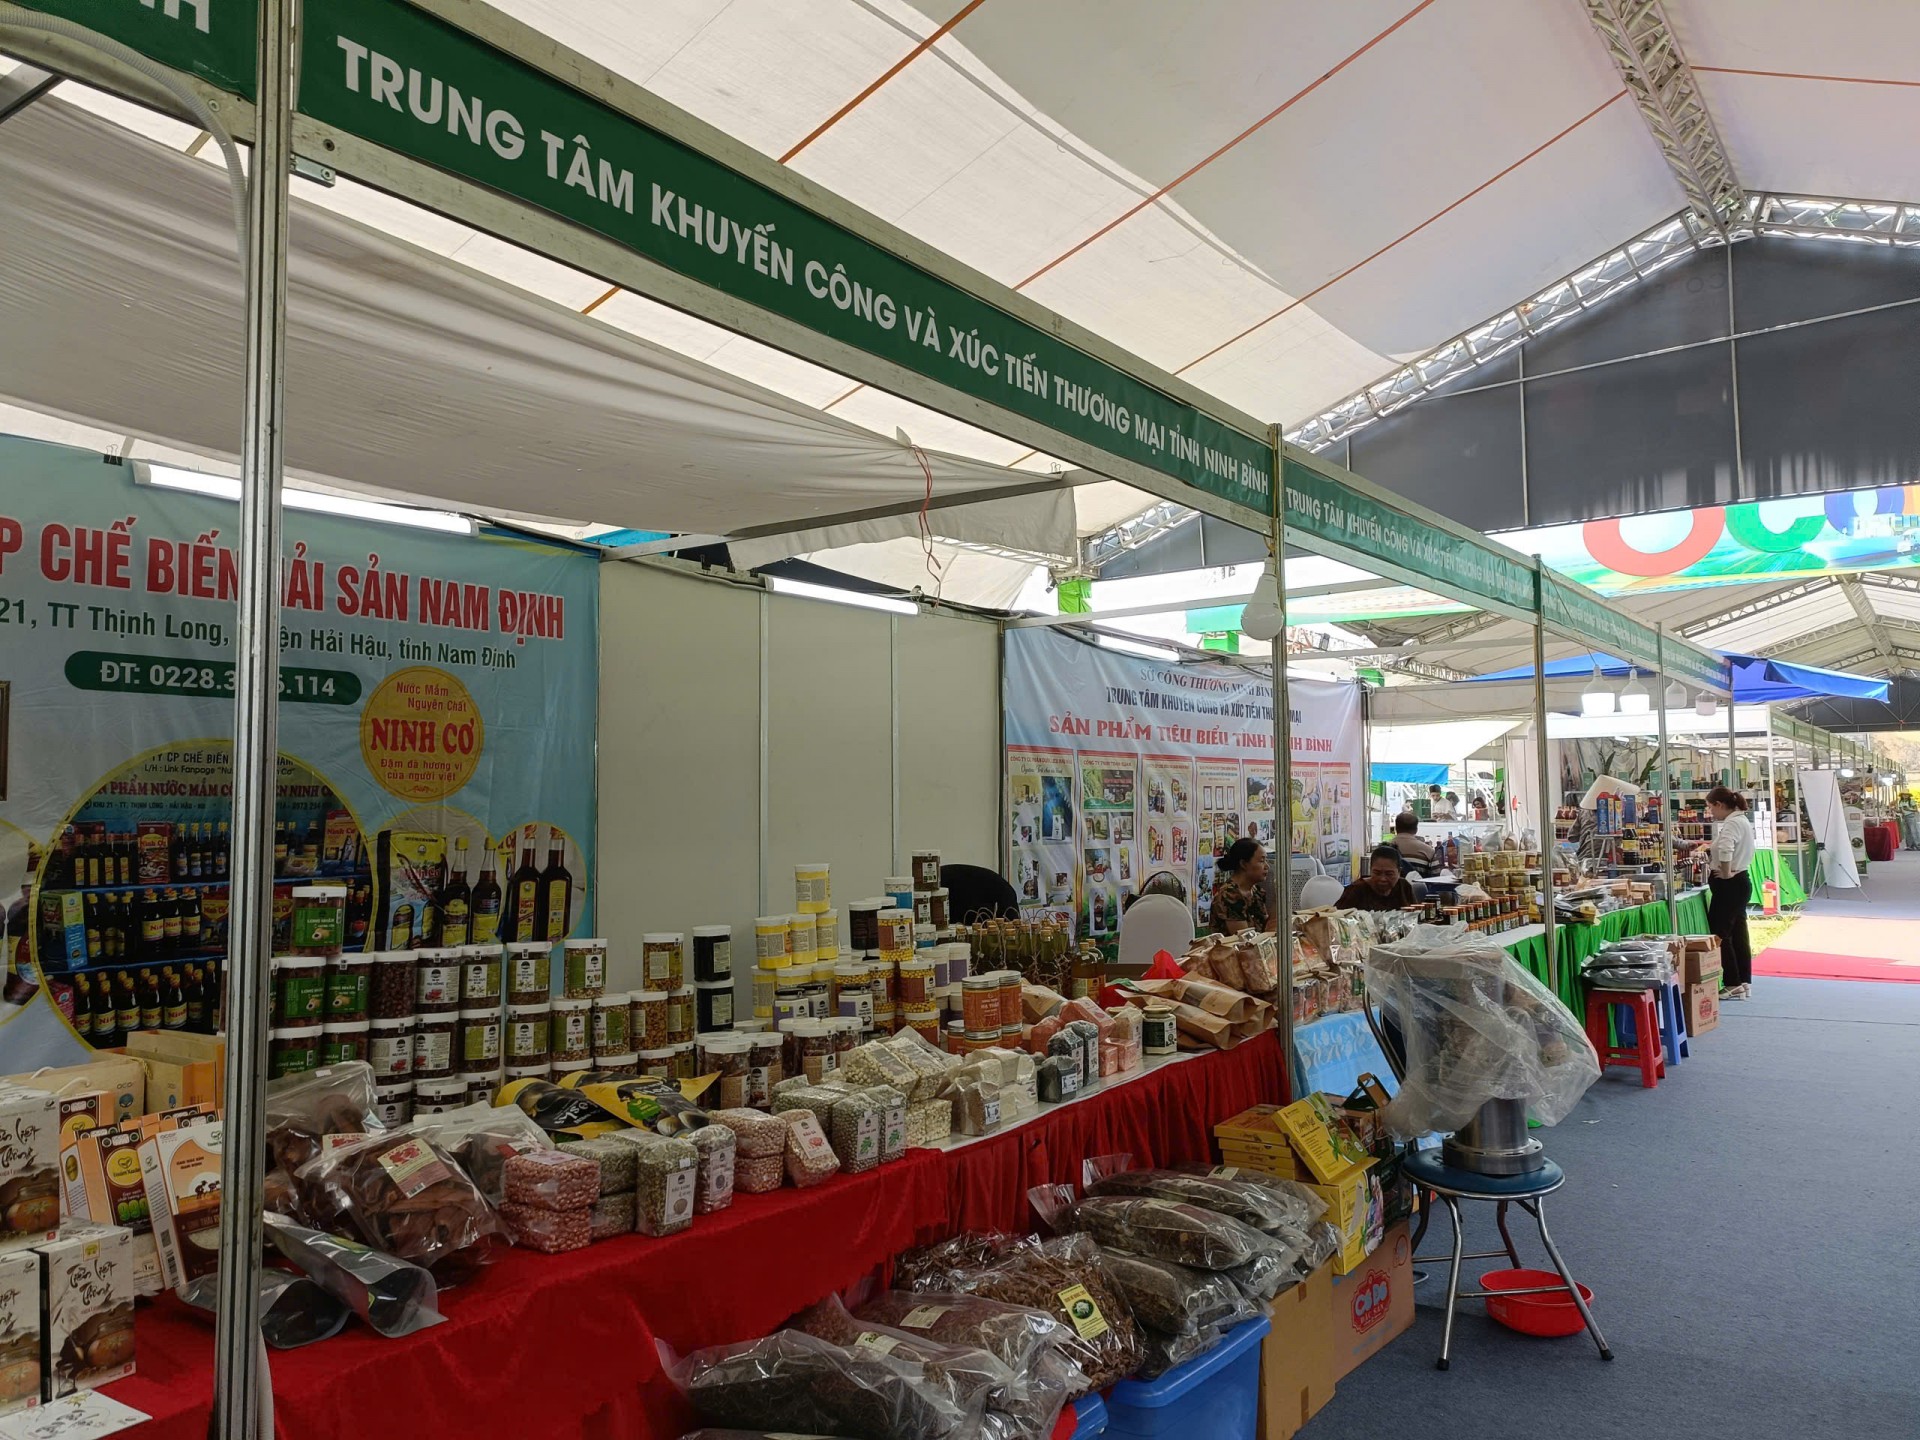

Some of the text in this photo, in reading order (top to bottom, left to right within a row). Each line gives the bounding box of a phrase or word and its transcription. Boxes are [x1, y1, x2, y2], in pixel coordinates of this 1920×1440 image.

[337, 35, 1269, 496] TRUNG TÂM KHUYẾN CÔNG VÀ XÚC TIẾN THƯƠNG MẠI TỈNH NINH BÌNH
[1286, 487, 1321, 520] TRUNG
[1324, 500, 1344, 529] TÂM
[1348, 514, 1382, 541] KHUYẾN
[1384, 527, 1408, 553] CÔNG
[1410, 536, 1422, 558] VÀ
[40, 516, 137, 590] CHẾ
[147, 530, 240, 602] BIẾN
[281, 541, 324, 611] ẢI
[337, 553, 409, 622] SẢN
[419, 576, 490, 631] NAM
[498, 589, 564, 645] ĐỊNH
[48, 601, 80, 628] TT
[88, 606, 155, 639] Thịnh
[165, 614, 229, 646] Long,
[310, 628, 343, 653] Hải
[350, 632, 392, 661] Hậu,
[399, 637, 431, 661] tỉnh
[438, 643, 476, 666] Nam
[482, 647, 516, 672] Định
[100, 661, 140, 684] ĐT:
[1157, 669, 1188, 688] CÔNG
[1189, 675, 1230, 693] THƯƠNG
[396, 681, 421, 695] Nước
[408, 697, 467, 712] Nguyên Chất
[1106, 686, 1137, 706] TRUNG
[1140, 688, 1159, 709] TÂM
[1161, 691, 1195, 713] KHUYẾN
[1220, 699, 1230, 715] VÀ
[1230, 701, 1244, 718] XÚC
[1245, 701, 1261, 720] TIẾN
[370, 717, 475, 755] NINH CƠ
[1049, 711, 1333, 752] SẢN PHẨM TIÊU BIỂU TỈNH BÌNH
[167, 752, 180, 762] CP
[184, 750, 203, 764] CHẾ
[206, 749, 229, 765] BIẾN
[181, 765, 216, 776] Fanpage
[110, 774, 149, 796] PHẨM
[191, 777, 219, 798] MẮM
[289, 784, 320, 798] NINH
